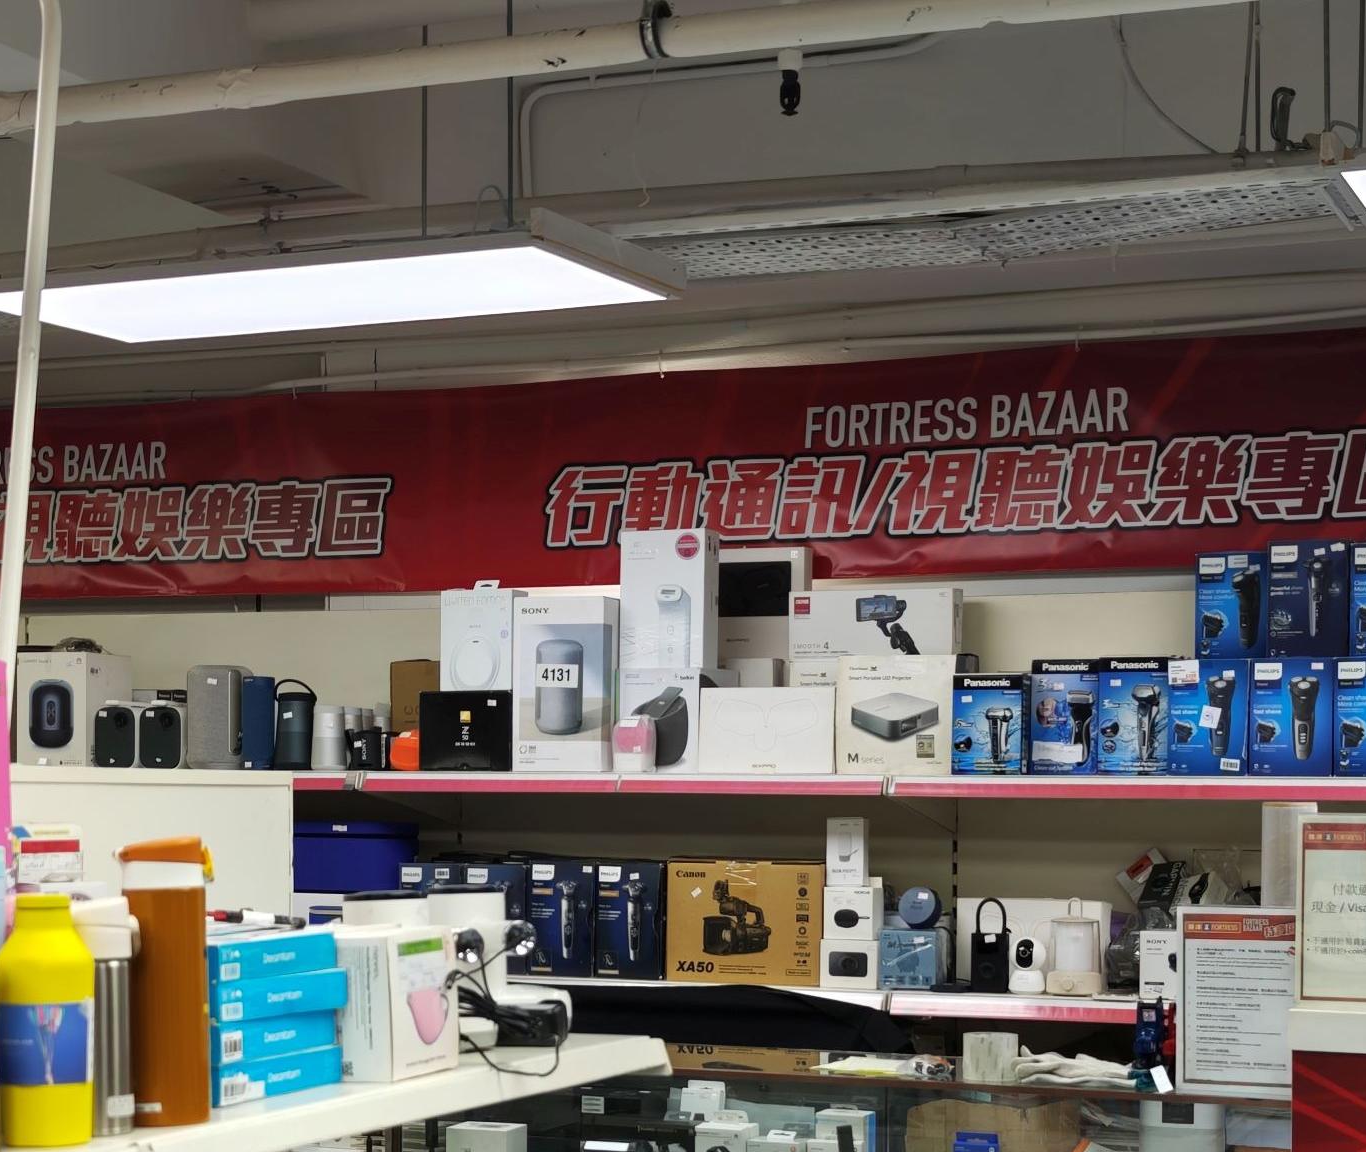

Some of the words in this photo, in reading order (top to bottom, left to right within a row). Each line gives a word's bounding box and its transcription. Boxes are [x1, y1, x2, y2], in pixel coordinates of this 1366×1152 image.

[805, 398, 978, 448] FORTRESS
[989, 386, 1129, 440] BAZAAR
[63, 441, 166, 484] BAZAAR
[521, 607, 549, 615] SONY
[823, 642, 829, 650] 4
[1042, 662, 1089, 672] Panasonic
[1110, 660, 1159, 670] Panasonic
[541, 668, 571, 683] 4131
[964, 678, 1011, 688] Panasonic
[461, 726, 470, 735] Z
[848, 753, 859, 763] M
[861, 756, 885, 765] series
[676, 870, 706, 879] Canon
[1311, 901, 1337, 914] 現金
[676, 961, 715, 974] XA50
